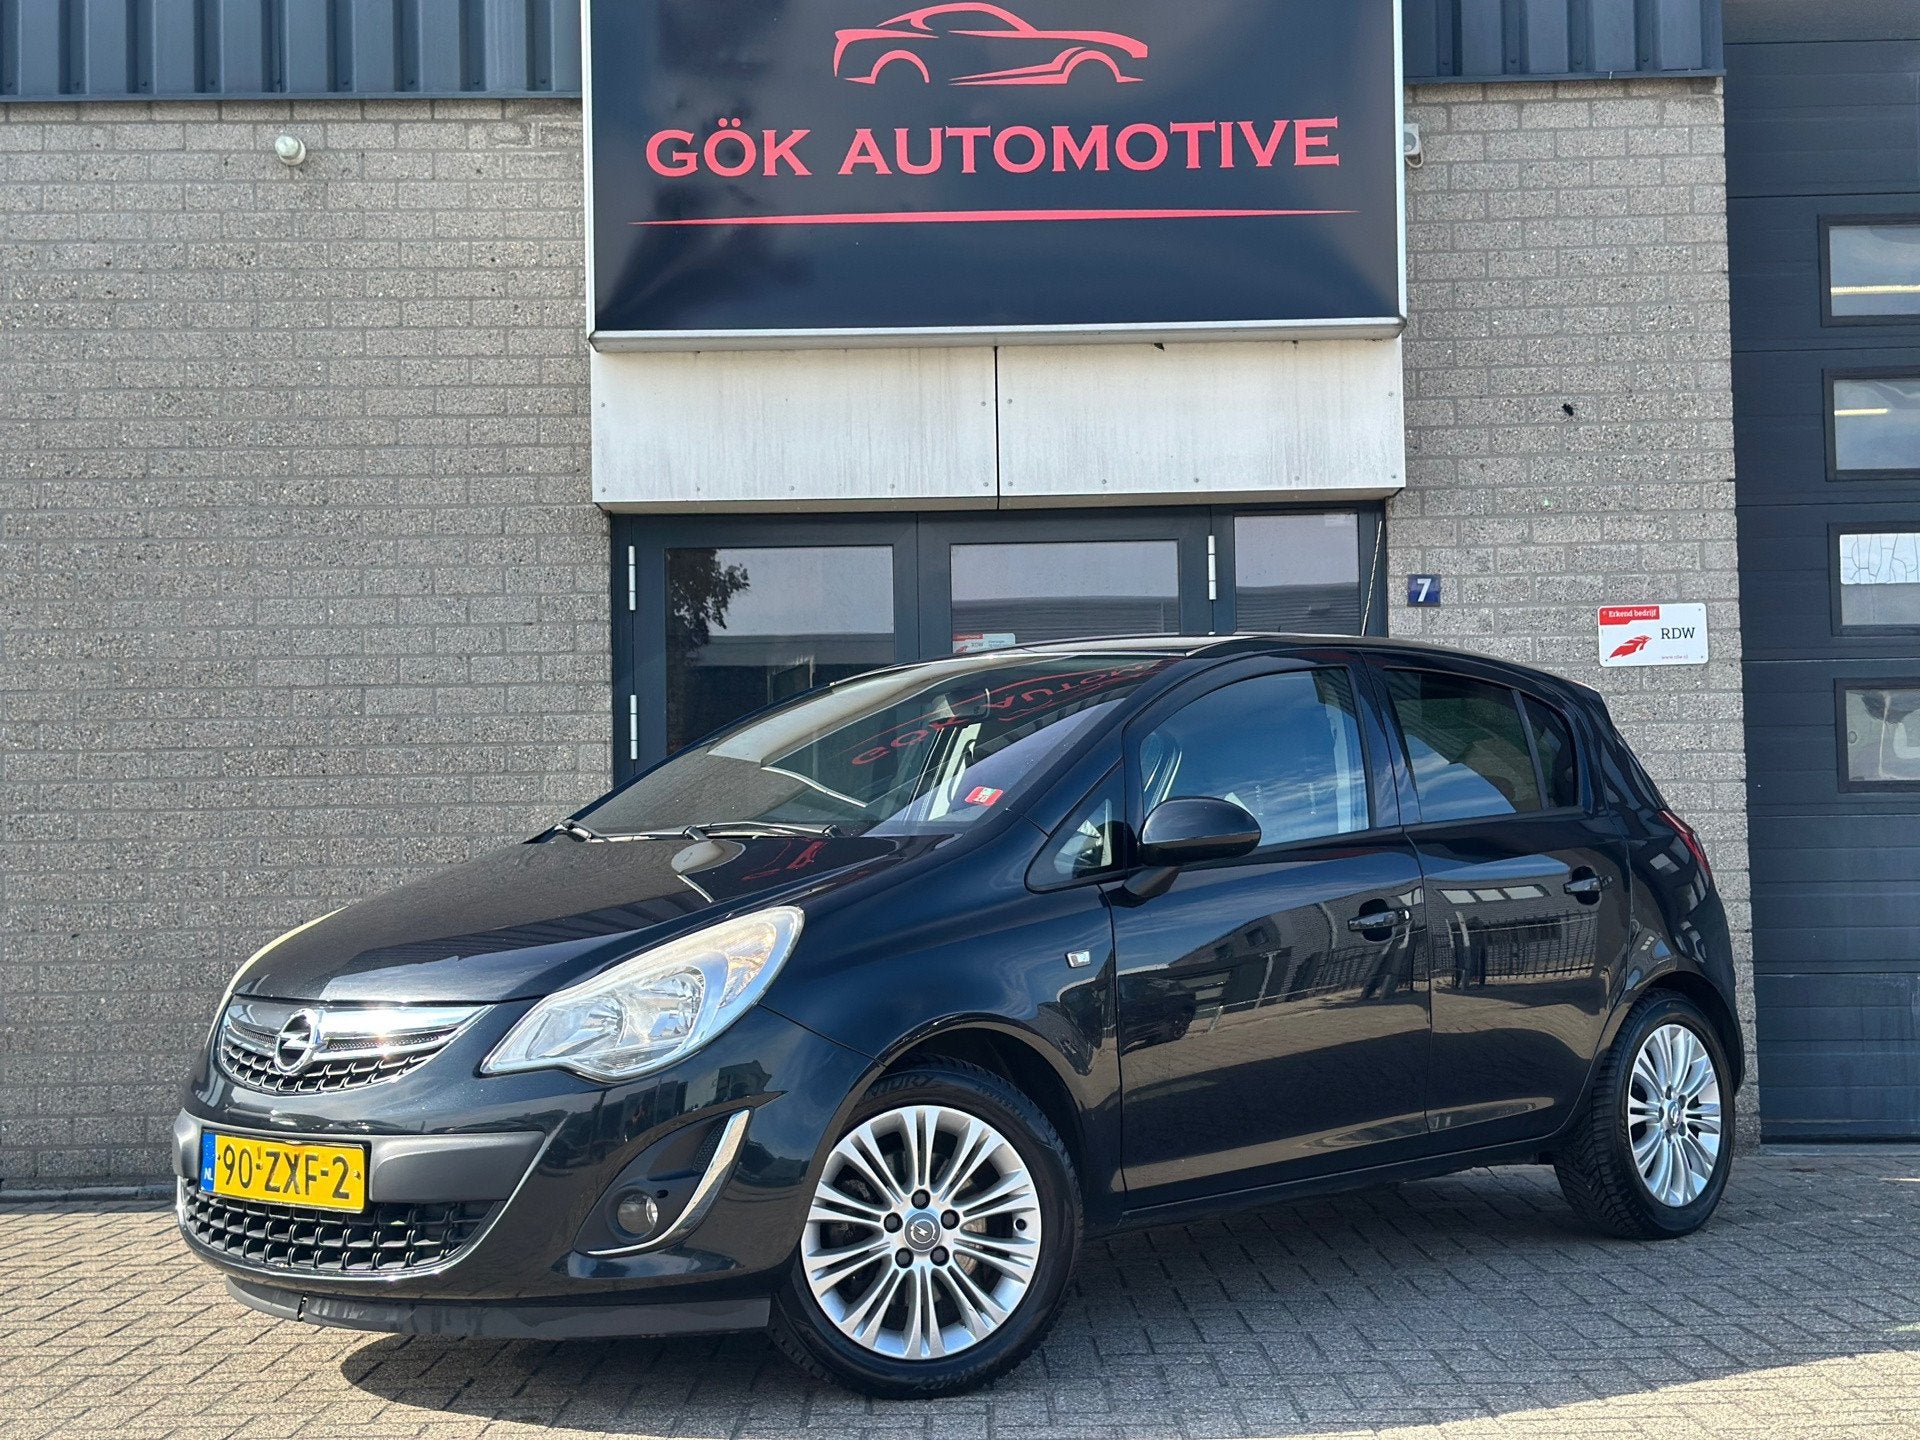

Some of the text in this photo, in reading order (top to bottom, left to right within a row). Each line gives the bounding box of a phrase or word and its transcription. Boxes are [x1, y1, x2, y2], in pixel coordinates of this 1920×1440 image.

[647, 118, 1339, 176] GÖK AUTOMOTIVE
[1417, 578, 1432, 602] 7
[1608, 609, 1657, 618] Erkend bedrijf
[1660, 627, 1695, 640] RDW
[204, 1167, 213, 1180] NL
[223, 1143, 350, 1200] 90-ZXF-2
